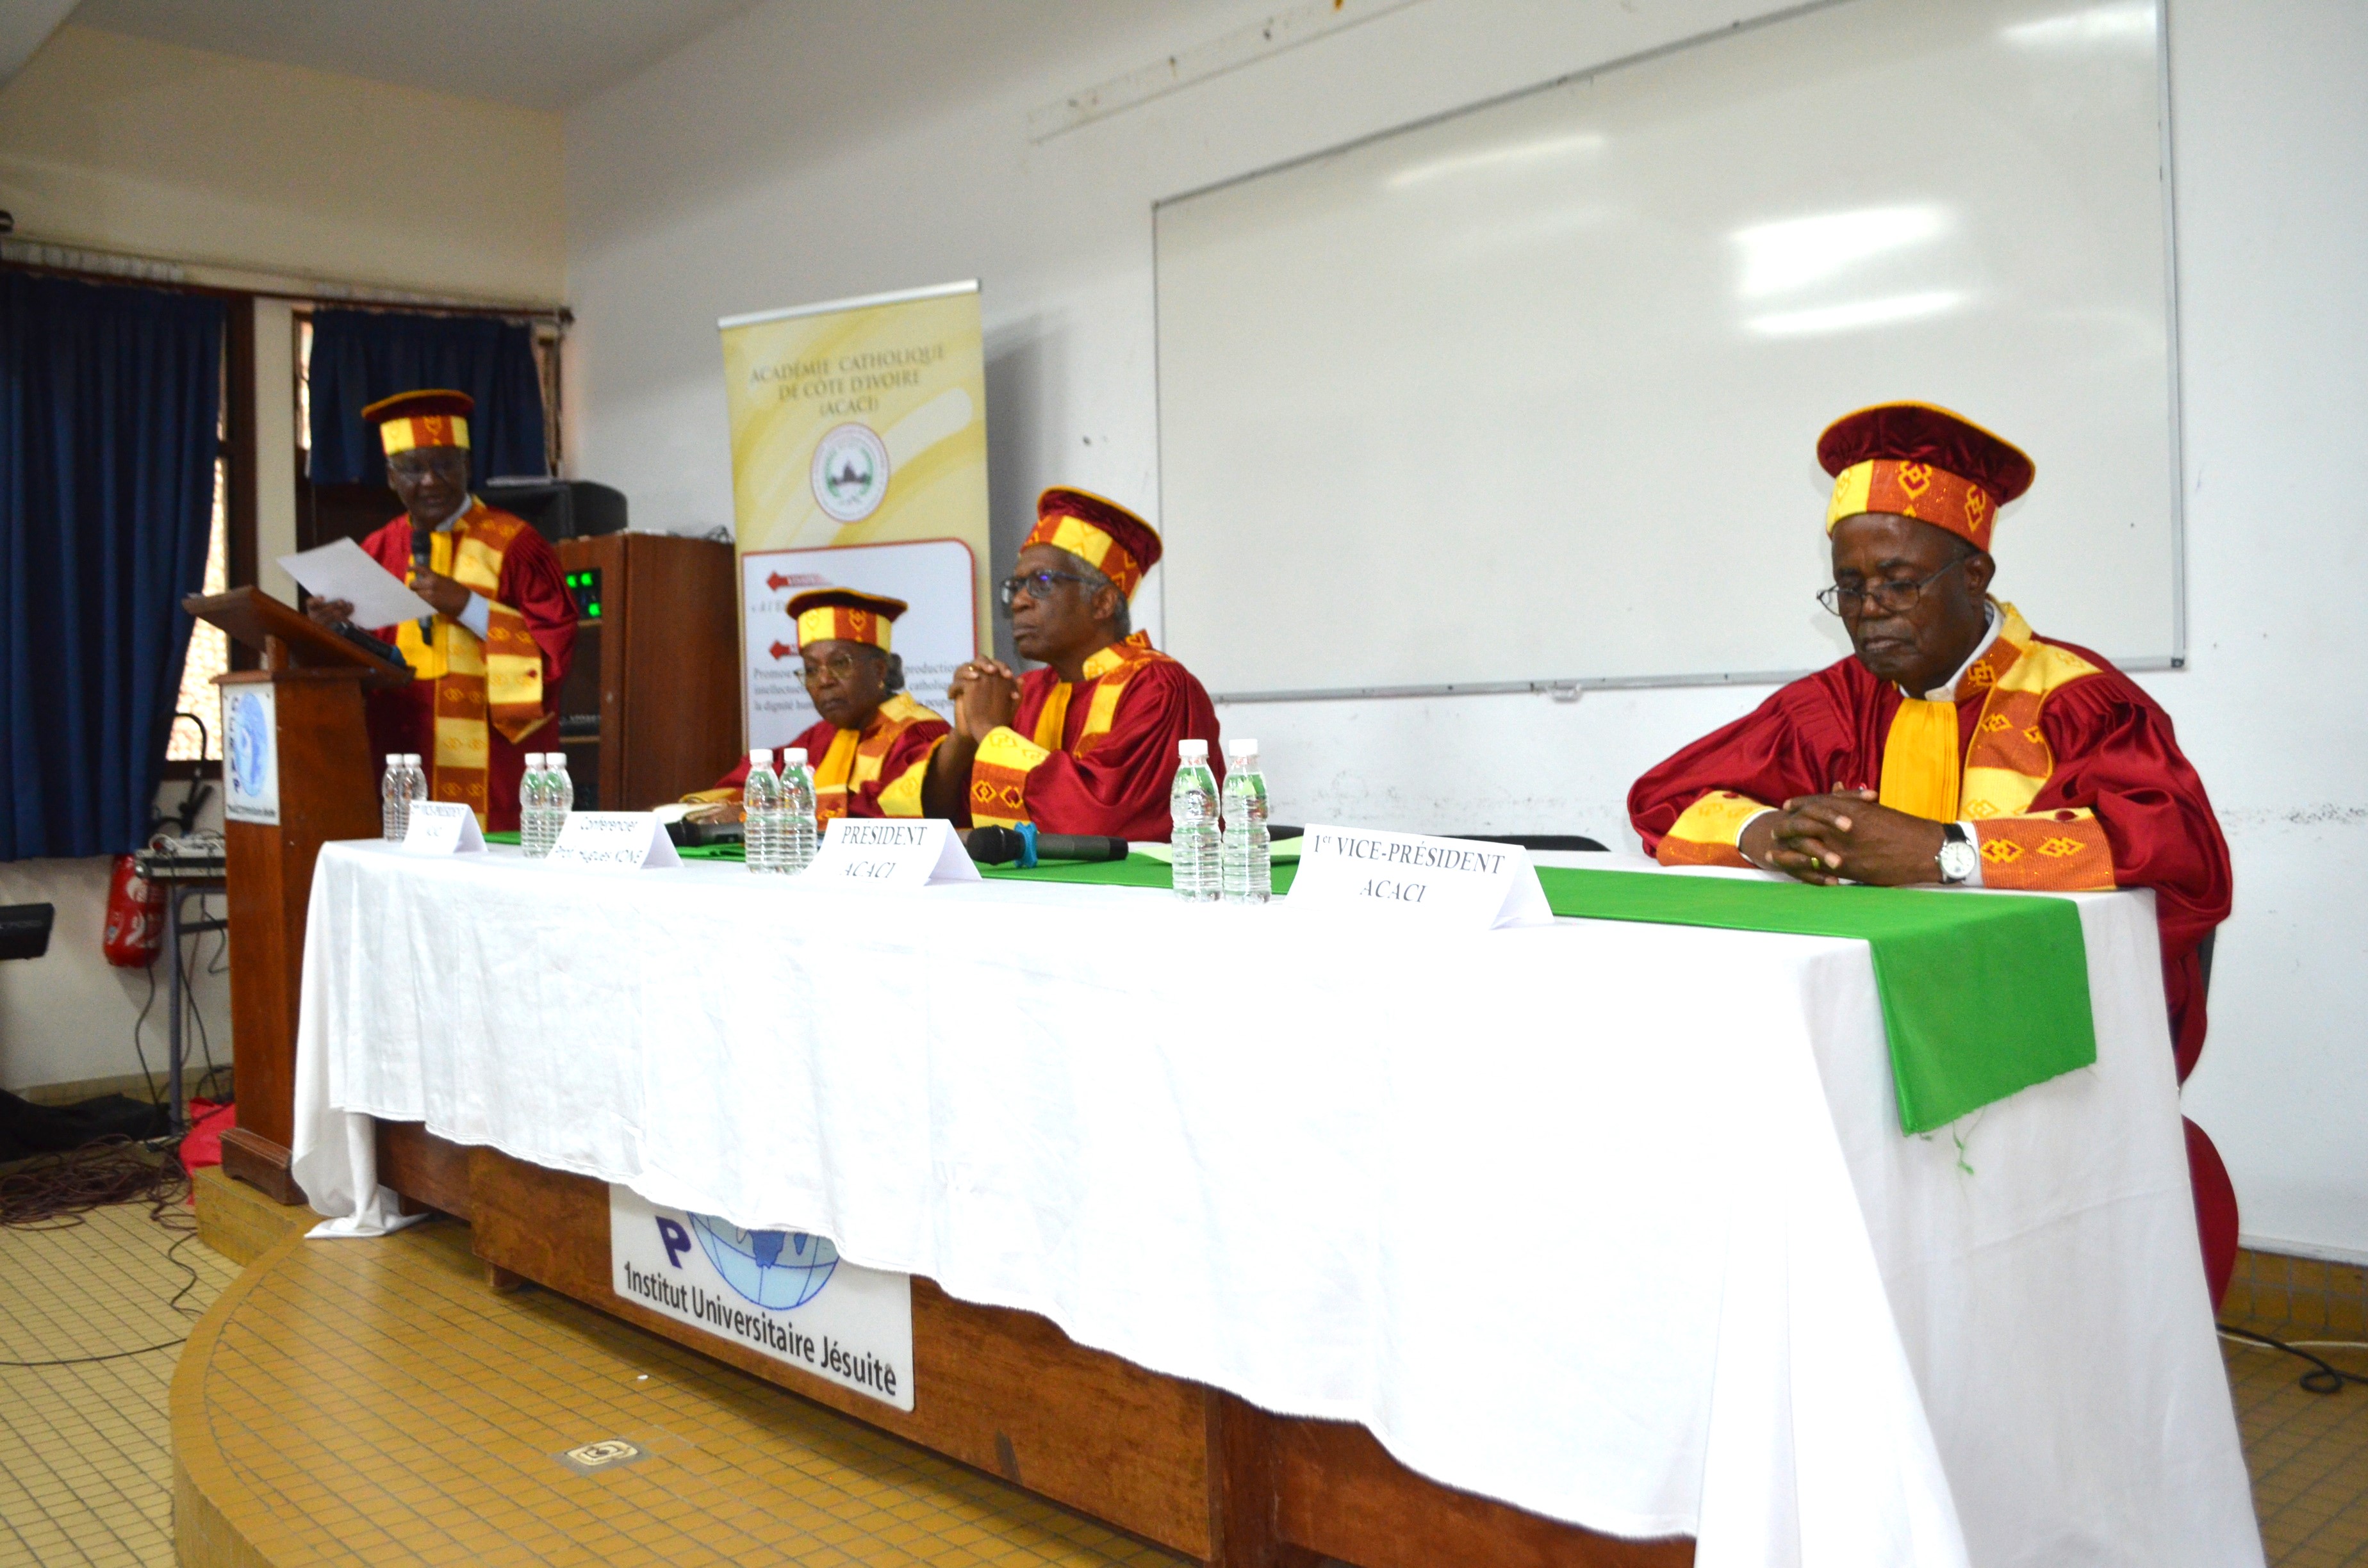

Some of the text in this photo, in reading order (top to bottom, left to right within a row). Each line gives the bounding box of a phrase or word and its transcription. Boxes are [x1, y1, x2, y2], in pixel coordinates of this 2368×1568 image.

[839, 343, 945, 372] CATHOLIQUE
[778, 383, 798, 401] DE
[840, 821, 928, 846] PRÉSIDENT
[1336, 837, 1506, 875] VICE-PRÉSIDENT
[839, 860, 897, 879] ACACI
[1358, 878, 1428, 904] ACACI
[691, 1288, 816, 1364] Universitaire
